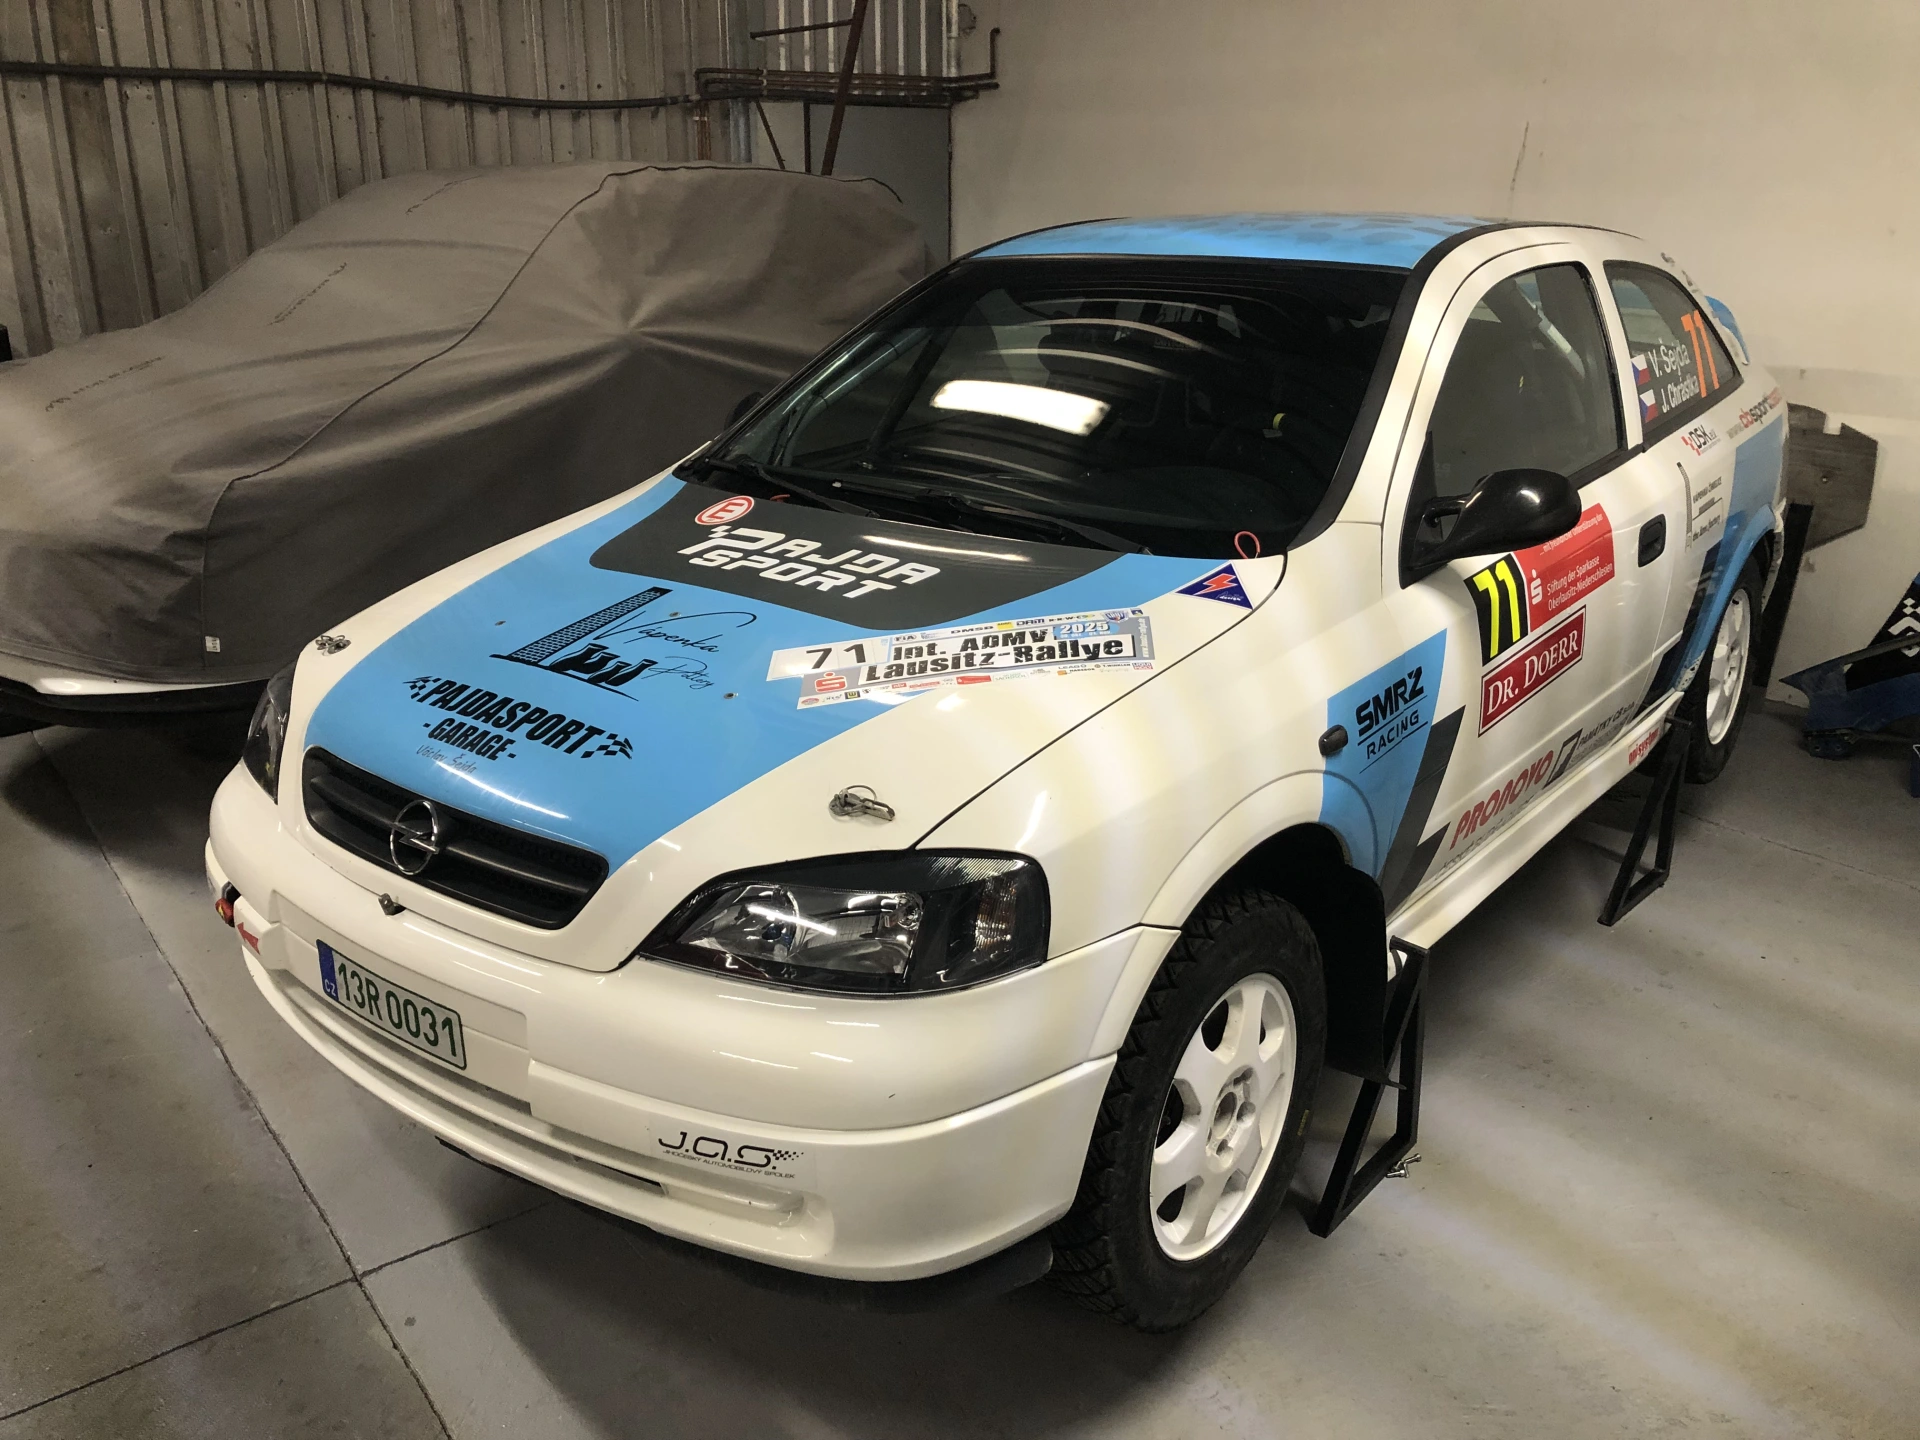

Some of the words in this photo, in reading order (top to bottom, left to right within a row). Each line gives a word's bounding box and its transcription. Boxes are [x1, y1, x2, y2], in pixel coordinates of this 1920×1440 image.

[1648, 349, 1662, 378] V.
[1681, 310, 1720, 398] 71
[677, 526, 940, 585] PAJDA
[688, 549, 897, 599] SPORT
[1547, 574, 1568, 596] Stiftung
[1567, 568, 1576, 583] der
[1575, 556, 1600, 578] Sparkasse
[1473, 560, 1520, 659] 71
[1548, 562, 1613, 611] Oberlausitz-Niederschlesien
[866, 639, 1123, 682] Lausitz-Rallye
[893, 642, 947, 661] Int.
[960, 629, 1048, 652] ADMV
[1060, 621, 1110, 635] 2025
[416, 679, 606, 754] PAJDASPORT
[1366, 709, 1419, 759] RACING
[324, 978, 337, 997] CZ
[338, 962, 383, 1022] 13R
[385, 990, 457, 1057] 0031
[764, 1169, 796, 1179] SPOLEK
